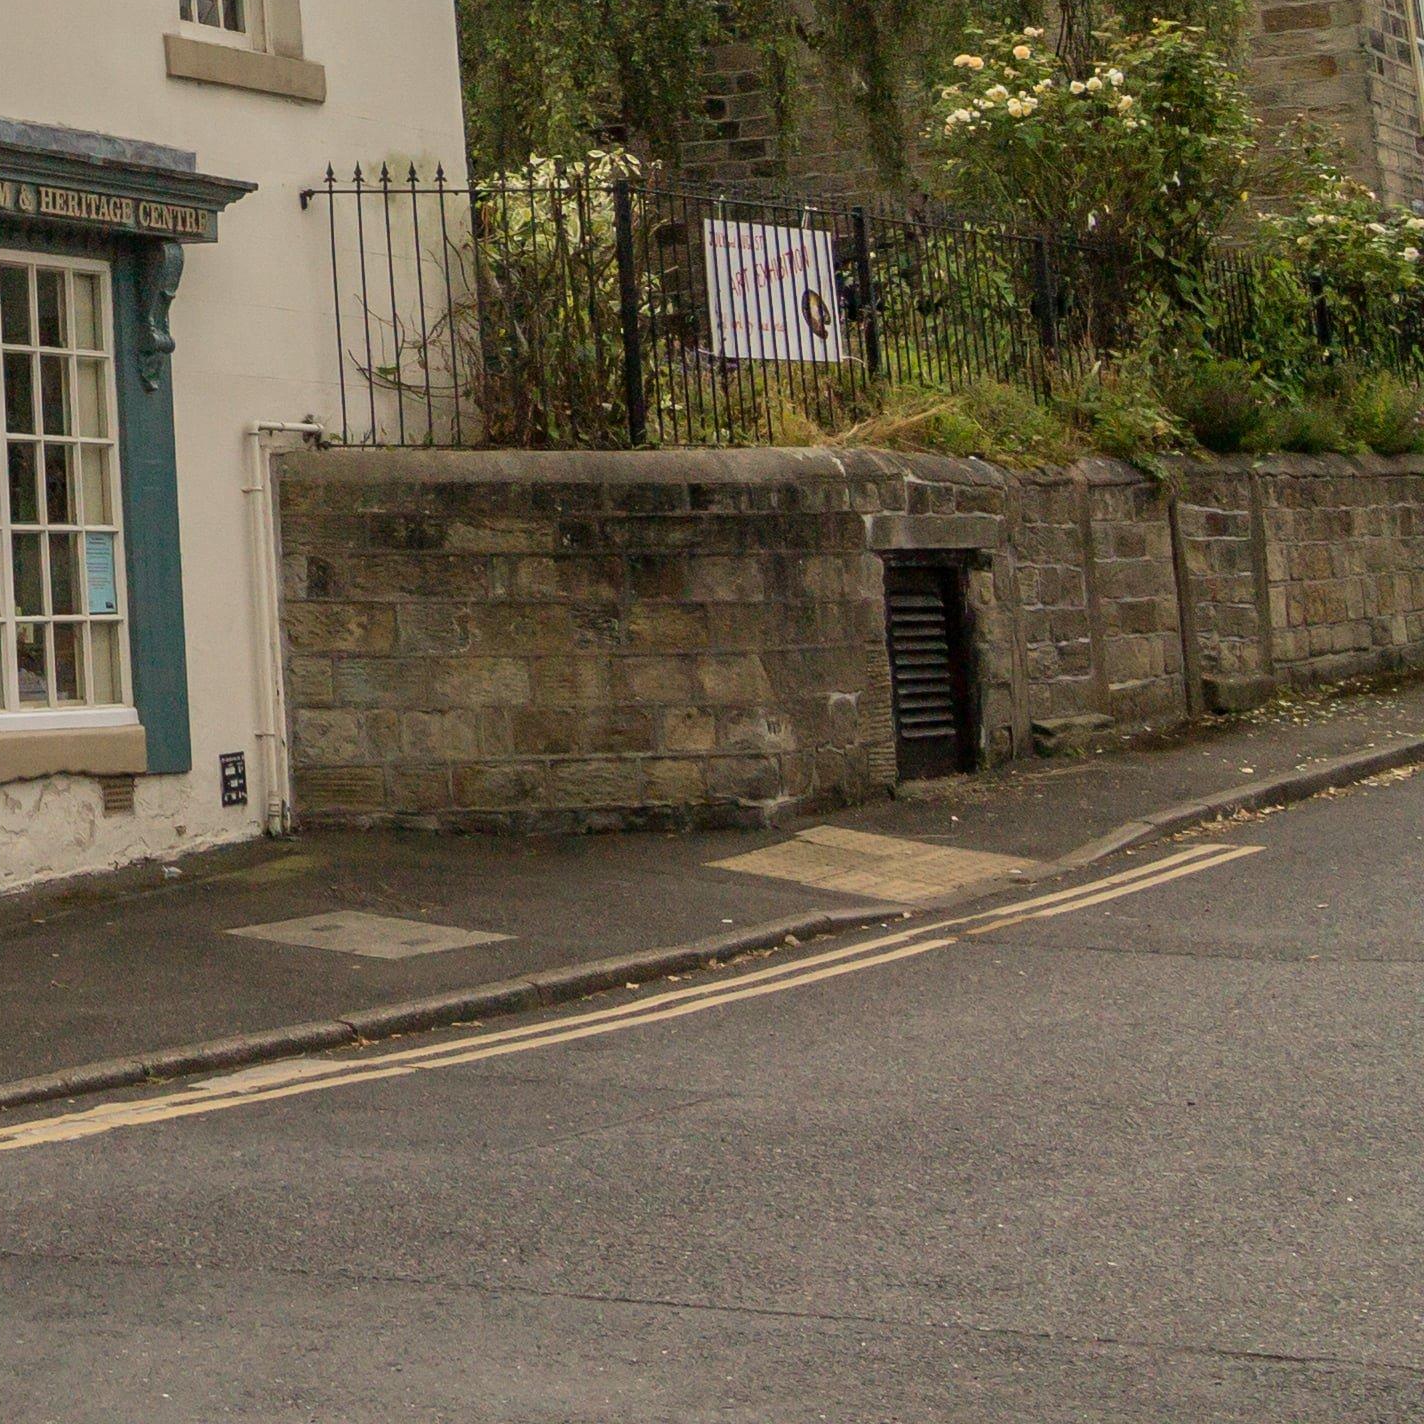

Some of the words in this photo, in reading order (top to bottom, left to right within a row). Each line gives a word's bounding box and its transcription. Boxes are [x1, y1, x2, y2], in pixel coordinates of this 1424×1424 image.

[19, 182, 35, 212] &
[39, 186, 135, 225] HERITAGE
[139, 200, 209, 234] CENTRE
